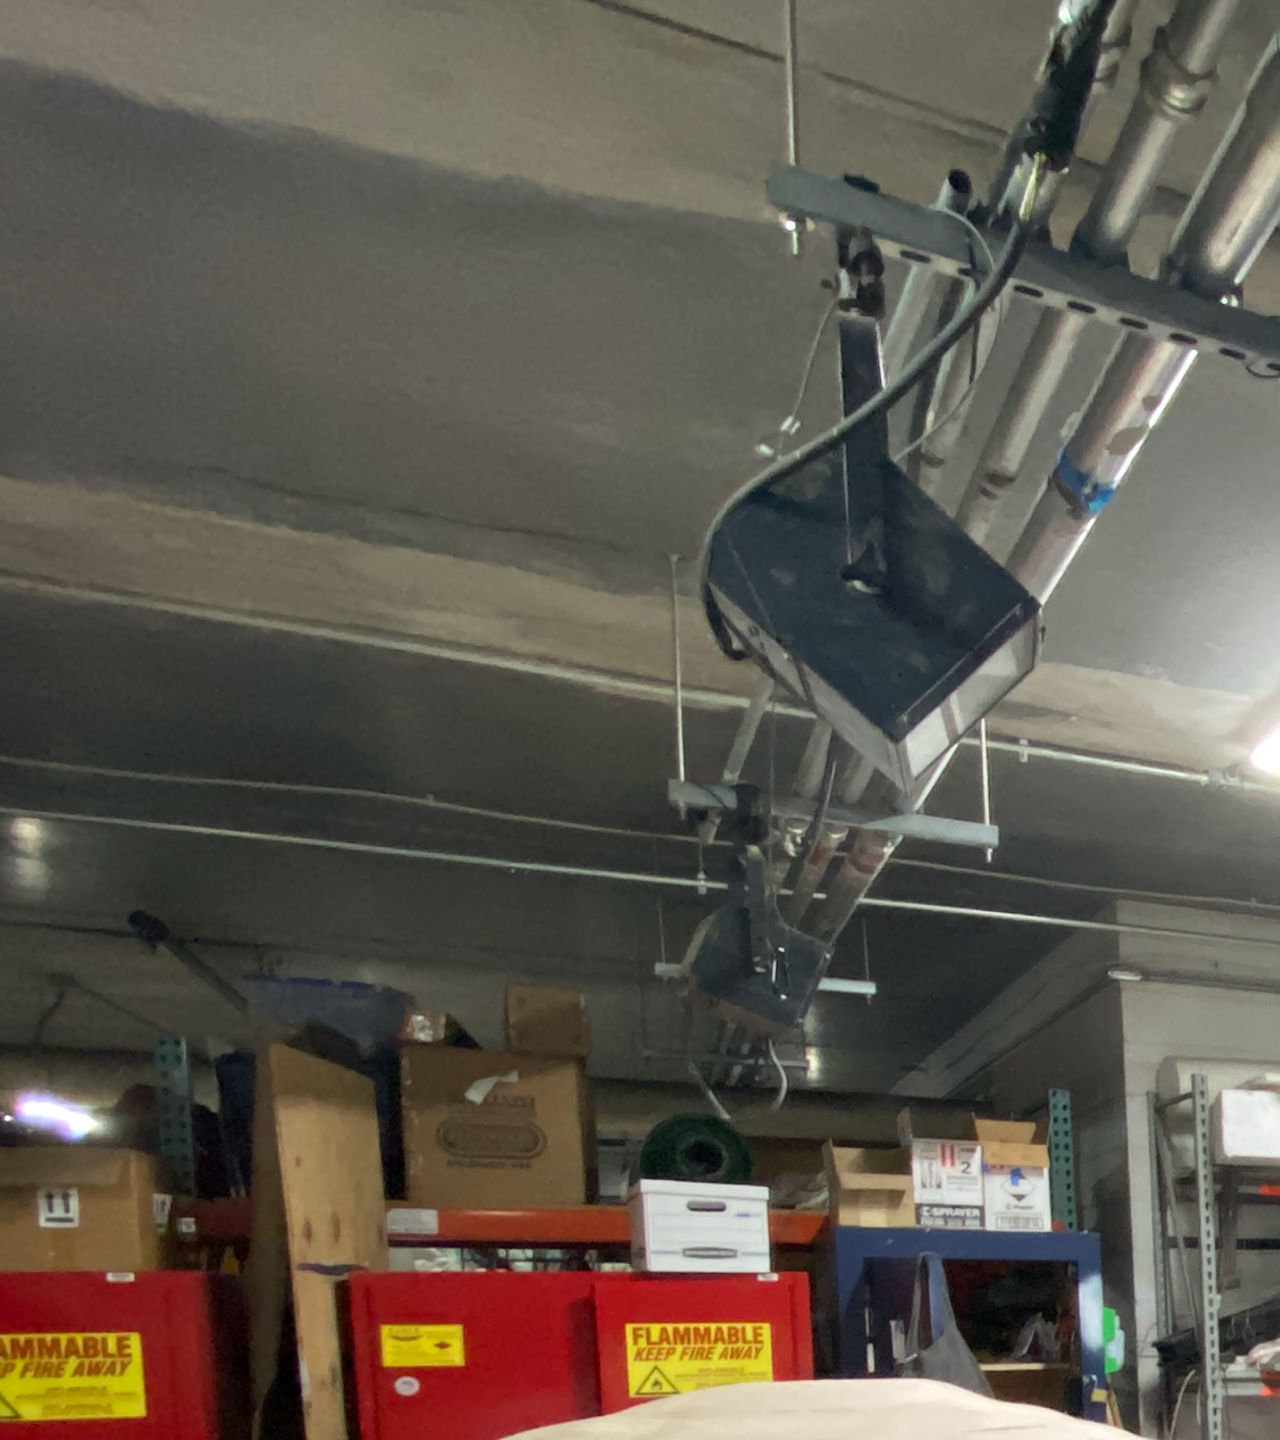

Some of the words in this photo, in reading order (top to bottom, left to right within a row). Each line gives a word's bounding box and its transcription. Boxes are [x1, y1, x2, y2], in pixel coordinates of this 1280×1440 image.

[960, 1161, 972, 1175] 2
[932, 1207, 980, 1217] SPRAYER
[632, 1326, 764, 1345] FLAMMABLE
[633, 1346, 677, 1362] KEEP
[679, 1346, 715, 1361] FIRE
[717, 1345, 763, 1360] AWAY
[19, 1360, 69, 1378] FIRE
[71, 1360, 132, 1377] AWAY
